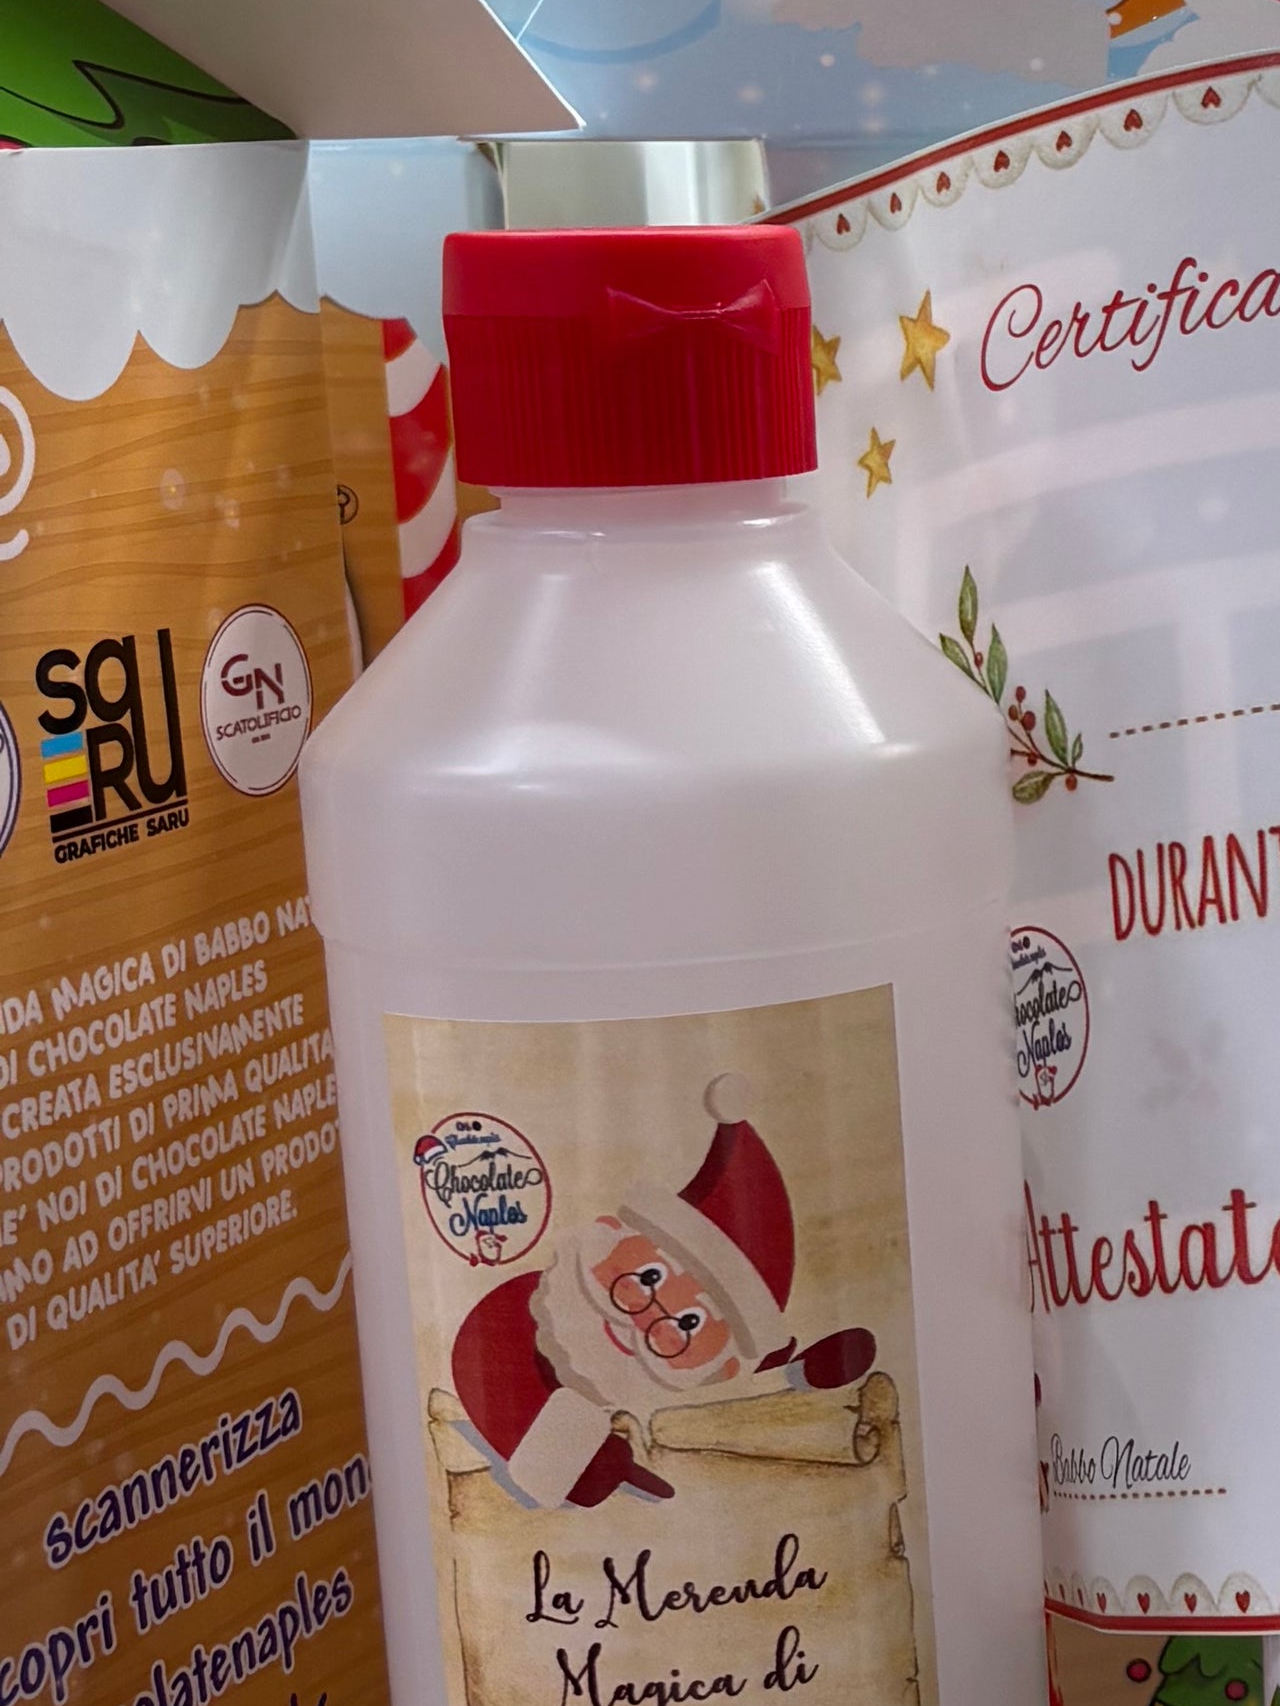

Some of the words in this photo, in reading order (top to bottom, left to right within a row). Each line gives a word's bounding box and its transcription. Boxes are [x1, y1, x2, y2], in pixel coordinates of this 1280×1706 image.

[215, 704, 302, 742] SCATOLIFICIO
[220, 653, 286, 711] GN
[54, 821, 140, 865] GRAFICHE
[146, 808, 191, 841] SARU
[51, 951, 156, 1023] MAGICA
[160, 939, 188, 980] DI
[194, 908, 272, 967] BABBO
[275, 895, 311, 939] NA
[1, 1072, 101, 1142] CREATA
[107, 992, 305, 1101] ESCLUSIVAMENTE
[27, 992, 178, 1079] CHOCOLATE
[183, 958, 269, 1022] NAPLES
[37, 1179, 87, 1233] NOI
[95, 1164, 123, 1209] DI
[130, 1103, 267, 1192] CHOCOLATE
[272, 1072, 339, 1132] NAPLE
[128, 1100, 155, 1144] DI
[161, 1067, 240, 1131] PRIMA
[61, 1229, 100, 1274] AD
[106, 1174, 213, 1253] OFFRIRVI
[218, 1156, 257, 1204] UN
[260, 1118, 342, 1185] PRODO
[426, 1157, 543, 1209] Chocolate
[449, 1193, 529, 1237] Naples
[5, 1304, 37, 1353] DI
[45, 1248, 162, 1331] QUALITA'
[169, 1187, 299, 1277] SUPERIORE.
[45, 1390, 301, 1565] scannerizza
[1050, 1433, 1097, 1486] Babbo
[1100, 1435, 1193, 1490] Natale
[131, 1535, 233, 1632] tutto
[248, 1491, 275, 1565] il
[290, 1455, 370, 1539] mon
[525, 1549, 584, 1625] La
[594, 1532, 829, 1629] Merenda
[762, 1624, 820, 1692] di
